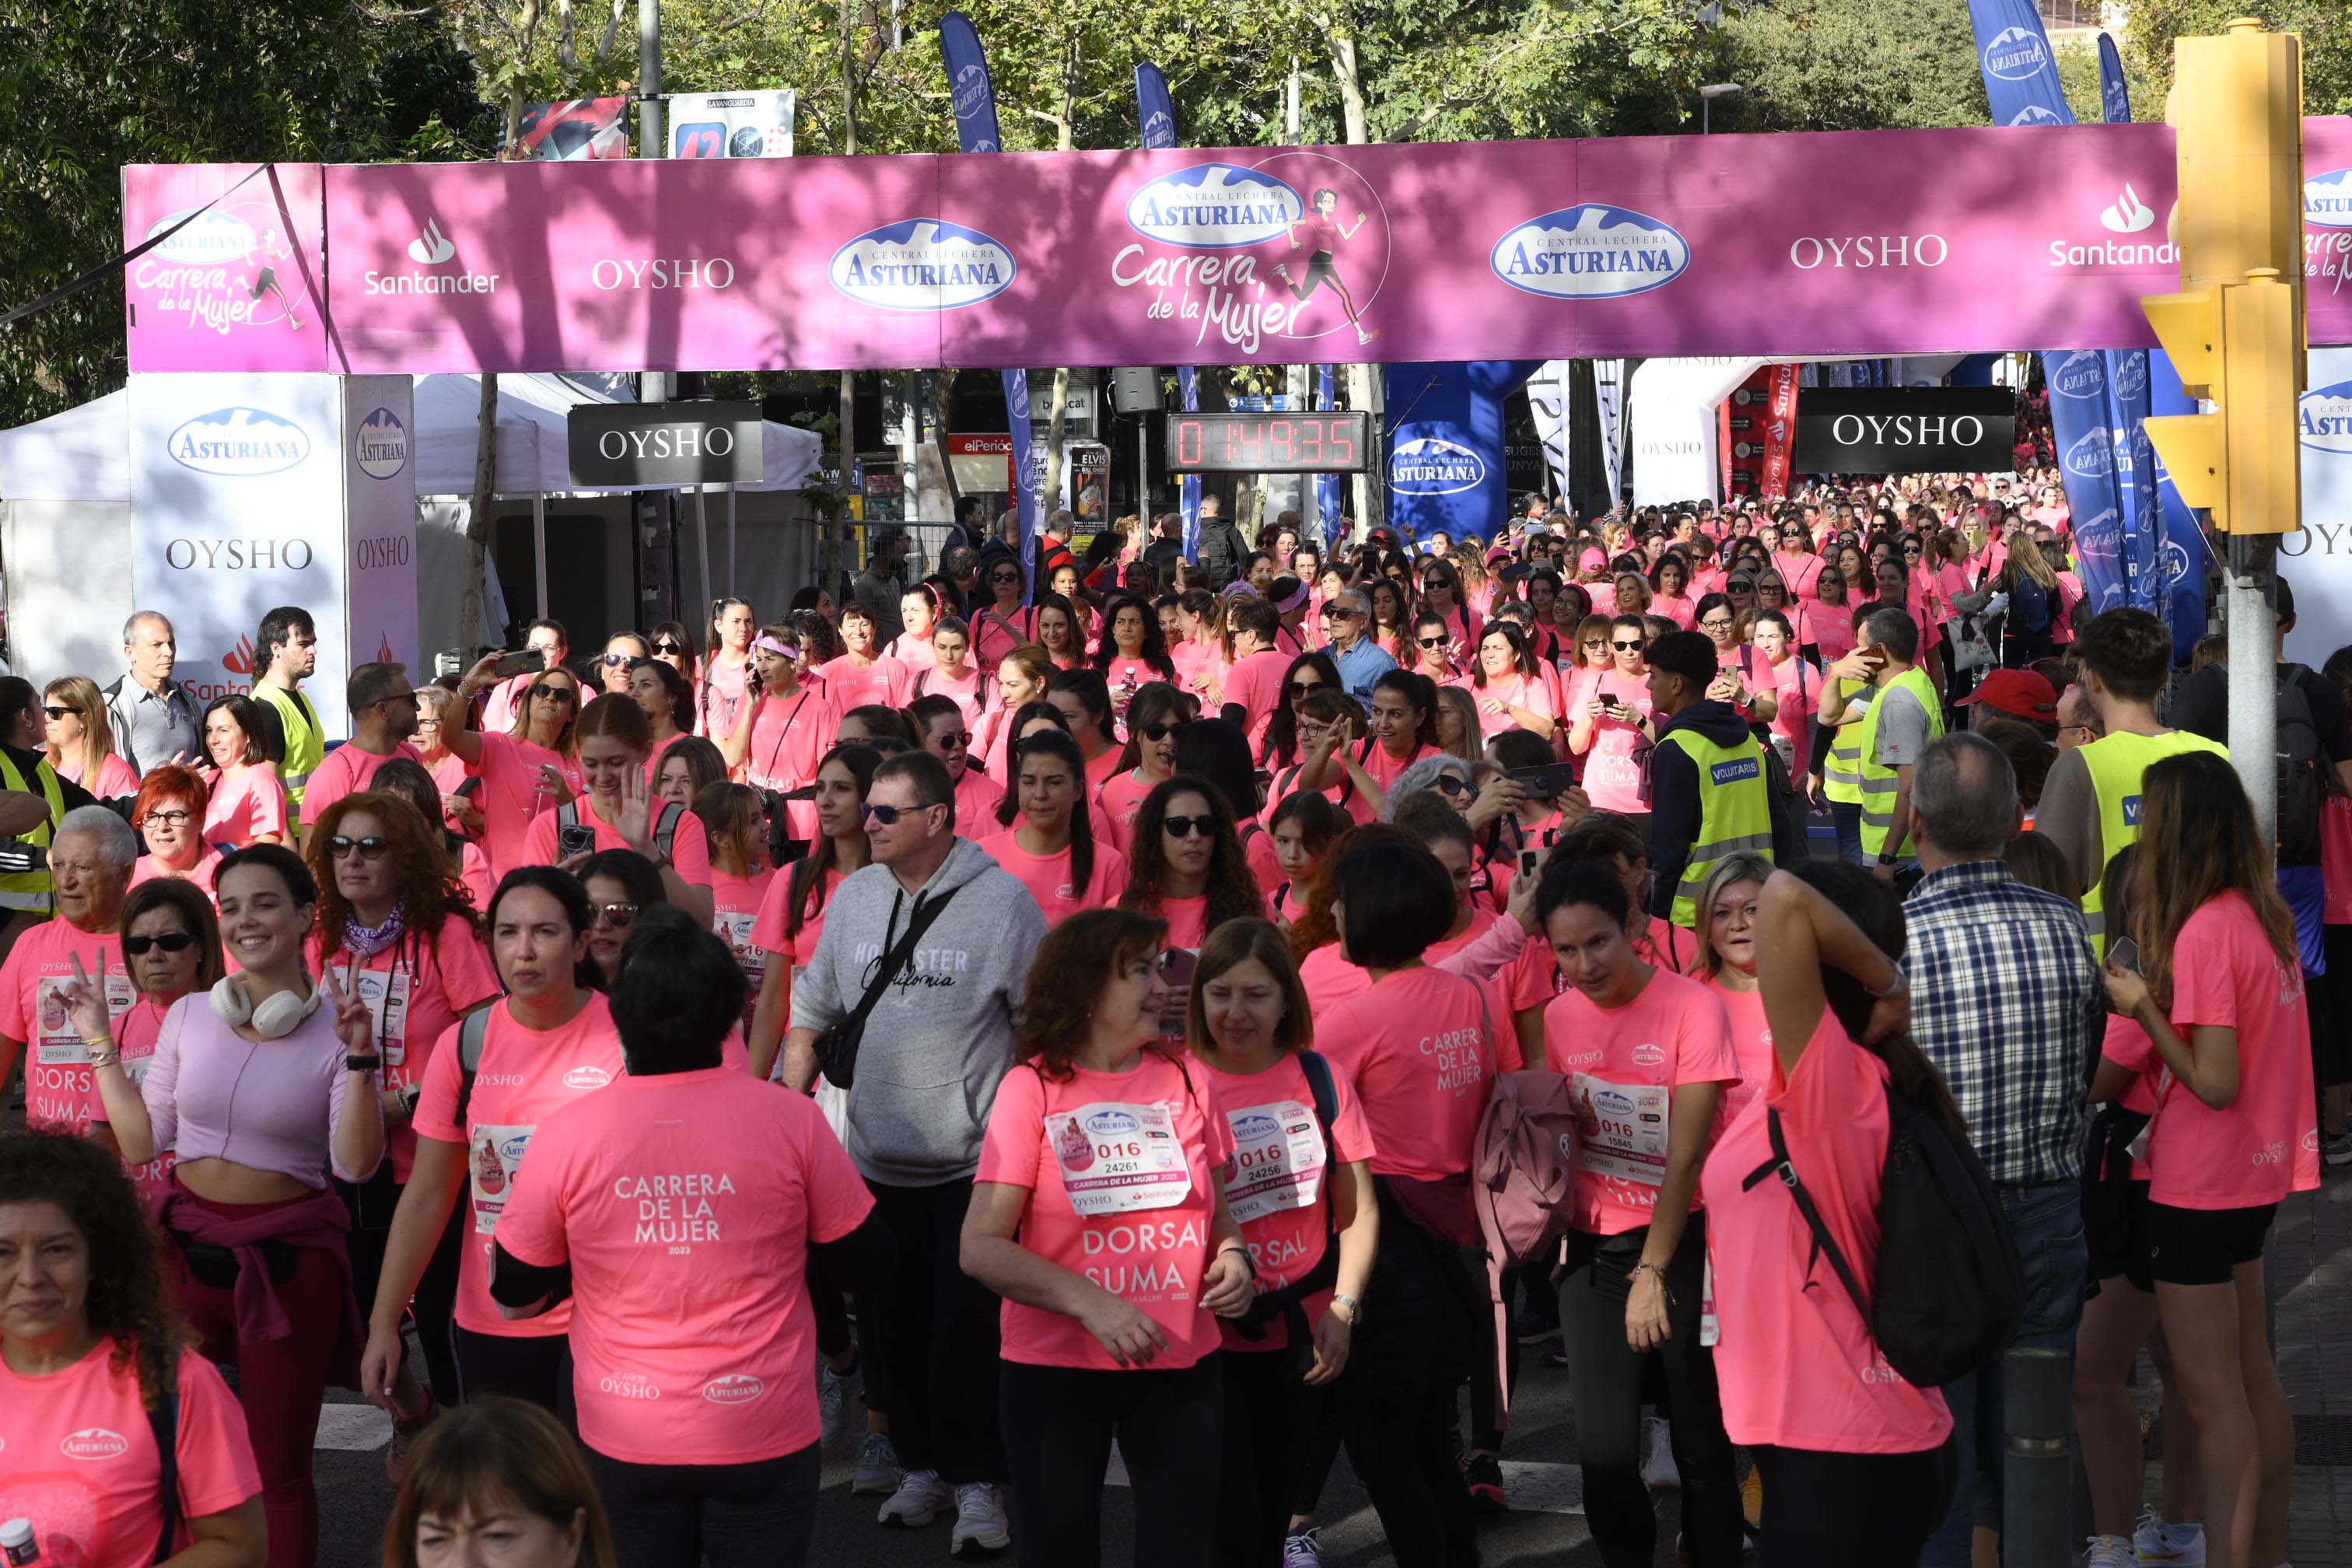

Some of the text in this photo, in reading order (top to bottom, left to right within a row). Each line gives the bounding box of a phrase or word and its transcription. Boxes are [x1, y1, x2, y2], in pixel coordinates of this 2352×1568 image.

[715, 98, 754, 107] VANGUARDIA
[1140, 196, 1289, 226] ASTURIANA
[1536, 235, 1668, 247] CENTRAL LECHERA
[1790, 233, 1948, 269] OYSHO
[872, 250, 927, 260] CENTRAL
[1111, 243, 1257, 287] Carrera
[1507, 240, 1674, 275] ASTURIANA
[135, 261, 226, 290] Carrera
[592, 257, 735, 290] OYSHO
[844, 253, 1001, 286] ASTURIANA
[364, 269, 499, 295] Santander
[158, 285, 262, 334] de la Mujer
[1147, 281, 1312, 355] de la Mujer
[1179, 419, 1353, 464] 01:49:35
[1833, 415, 1984, 446] OYSHO
[179, 432, 300, 459] ASTURIANA
[359, 434, 404, 462] ASTURIANA
[600, 427, 733, 460] OYSHO
[1642, 441, 1702, 455] OYSHO
[1082, 454, 1106, 464] ELVIS
[1390, 461, 1478, 483] ASTURIANA
[166, 538, 313, 570] OYSHO
[358, 535, 409, 570] OYSHO
[716, 904, 737, 912] SHO
[1438, 1050, 1479, 1069] DE LA
[37, 1066, 92, 1094] DORS
[474, 1074, 523, 1087] OYSHO
[1437, 1065, 1482, 1092] MUJER
[38, 1096, 92, 1123] SUMA
[1597, 1096, 1632, 1112] ASTURIANA
[1090, 1119, 1136, 1130] ASTURIANA
[1281, 1111, 1306, 1121] SUMA
[1601, 1120, 1633, 1137] 016
[1097, 1142, 1142, 1159] 016
[1608, 1137, 1633, 1149] 15845
[1105, 1162, 1139, 1173] 24261
[1240, 1145, 1283, 1168] 016
[1073, 1180, 1108, 1189] CARRERA
[1248, 1165, 1282, 1181] 24256
[614, 1173, 736, 1199] CARRERA
[1143, 1188, 1183, 1200] Santander
[1226, 1186, 1254, 1201] ARRERA
[1255, 1183, 1265, 1192] DE
[1265, 1181, 1276, 1190] LA
[1276, 1175, 1301, 1188] MUJER
[639, 1199, 714, 1220] DE LA
[1073, 1195, 1112, 1206] OYSHO
[1231, 1200, 1259, 1217] YSHO
[635, 1220, 721, 1244] MUJER
[1083, 1219, 1207, 1255] DORSAL
[668, 1246, 691, 1255] 2023
[1086, 1260, 1185, 1295] SUMA
[600, 1377, 660, 1400] OYSHO
[709, 1385, 760, 1398] ASTURIANA
